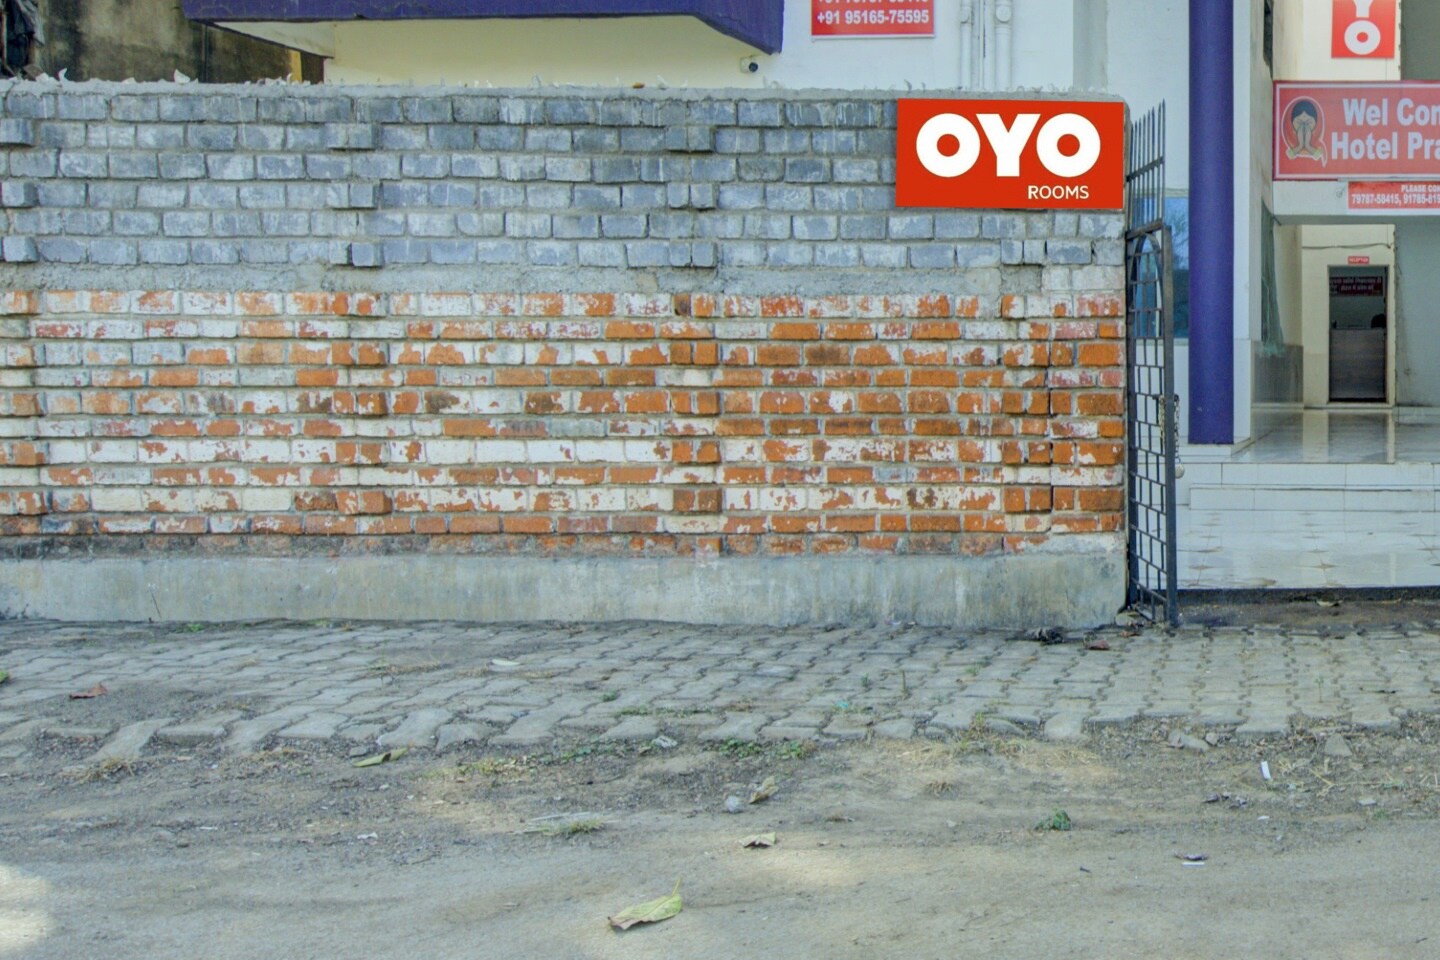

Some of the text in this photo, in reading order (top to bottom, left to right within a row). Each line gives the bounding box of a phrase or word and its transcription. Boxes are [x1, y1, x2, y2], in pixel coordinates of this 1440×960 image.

[817, 9, 929, 24] +91 95165-75595
[1342, 98, 1388, 126] Wel
[916, 113, 1101, 178] OYO
[1331, 131, 1398, 160] Hotel
[1028, 184, 1089, 200] ROOMS
[1401, 184, 1426, 193] PLEASE
